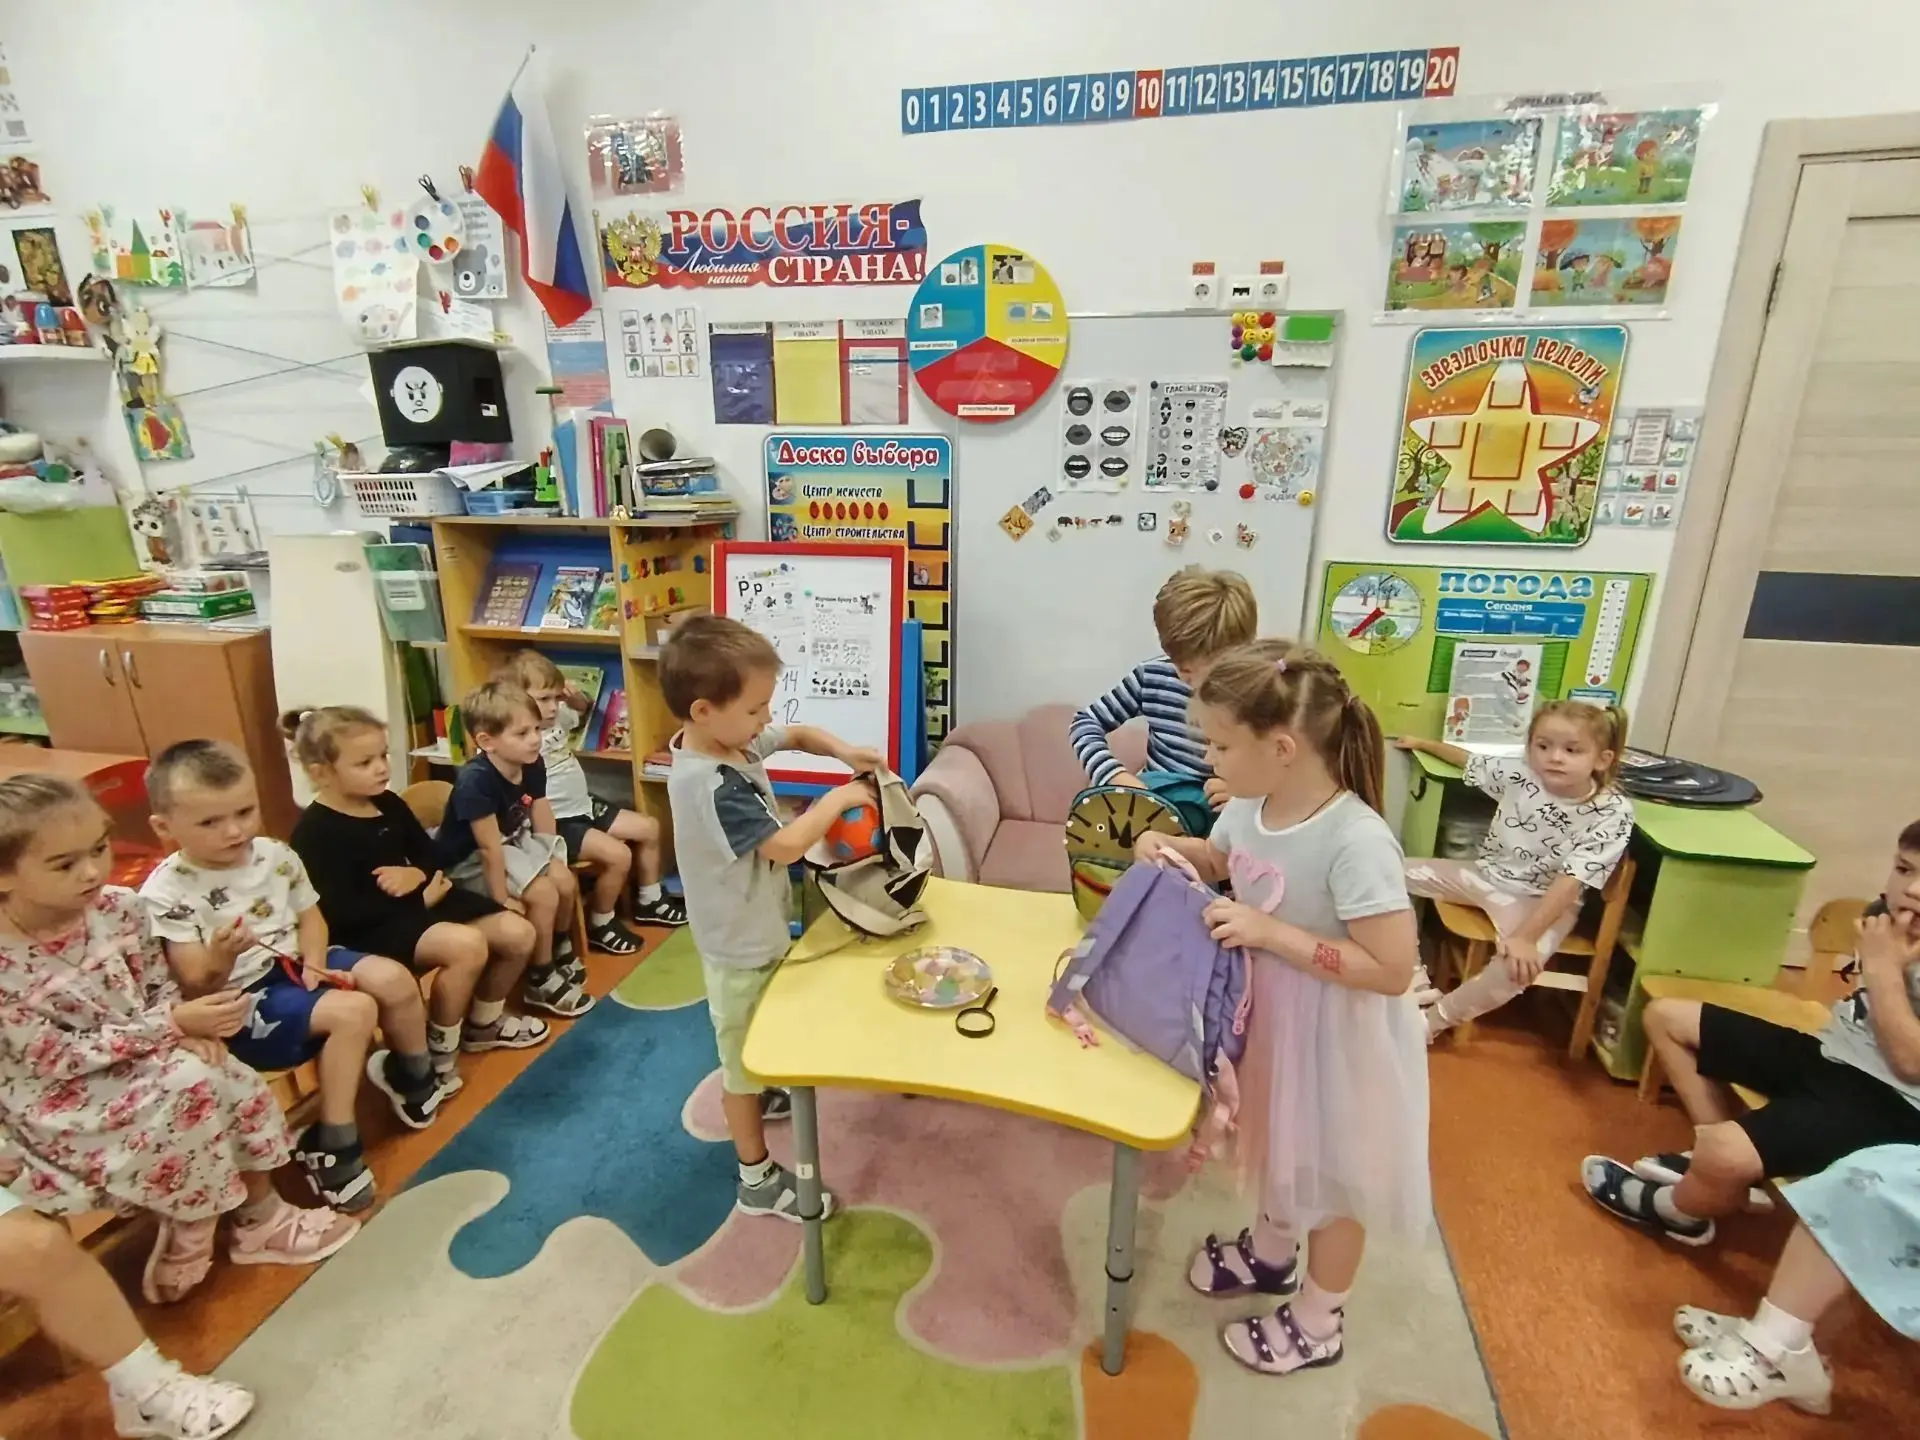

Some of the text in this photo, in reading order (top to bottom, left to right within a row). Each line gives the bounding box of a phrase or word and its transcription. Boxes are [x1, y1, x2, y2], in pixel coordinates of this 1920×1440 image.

[906, 55, 1455, 126] 0 1 2 3 4 5 6 7 8 9 10 11 12 13 14 15 16 17 18 19 20
[668, 246, 760, 275] Любимая
[707, 253, 923, 285] наша СТРАНА!
[778, 442, 938, 469] Доска выбора
[1485, 601, 1533, 612] Сегодня
[782, 670, 798, 692] 14
[783, 698, 801, 725] 12
